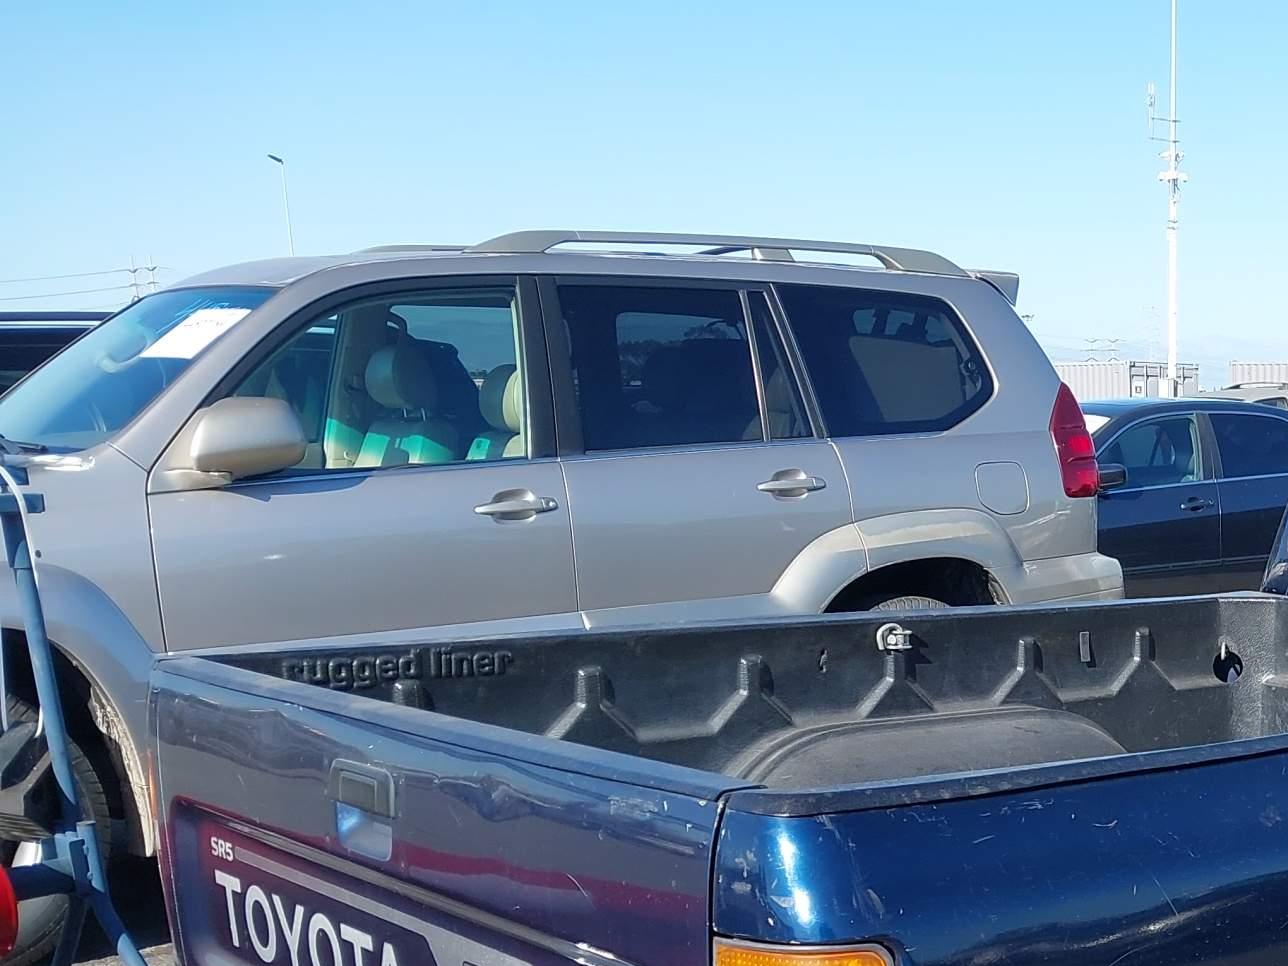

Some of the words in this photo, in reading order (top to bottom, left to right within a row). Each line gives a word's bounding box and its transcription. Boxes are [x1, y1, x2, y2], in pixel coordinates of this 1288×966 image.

[281, 648, 419, 690] rugged
[429, 647, 514, 678] liner
[210, 836, 234, 862] SR5
